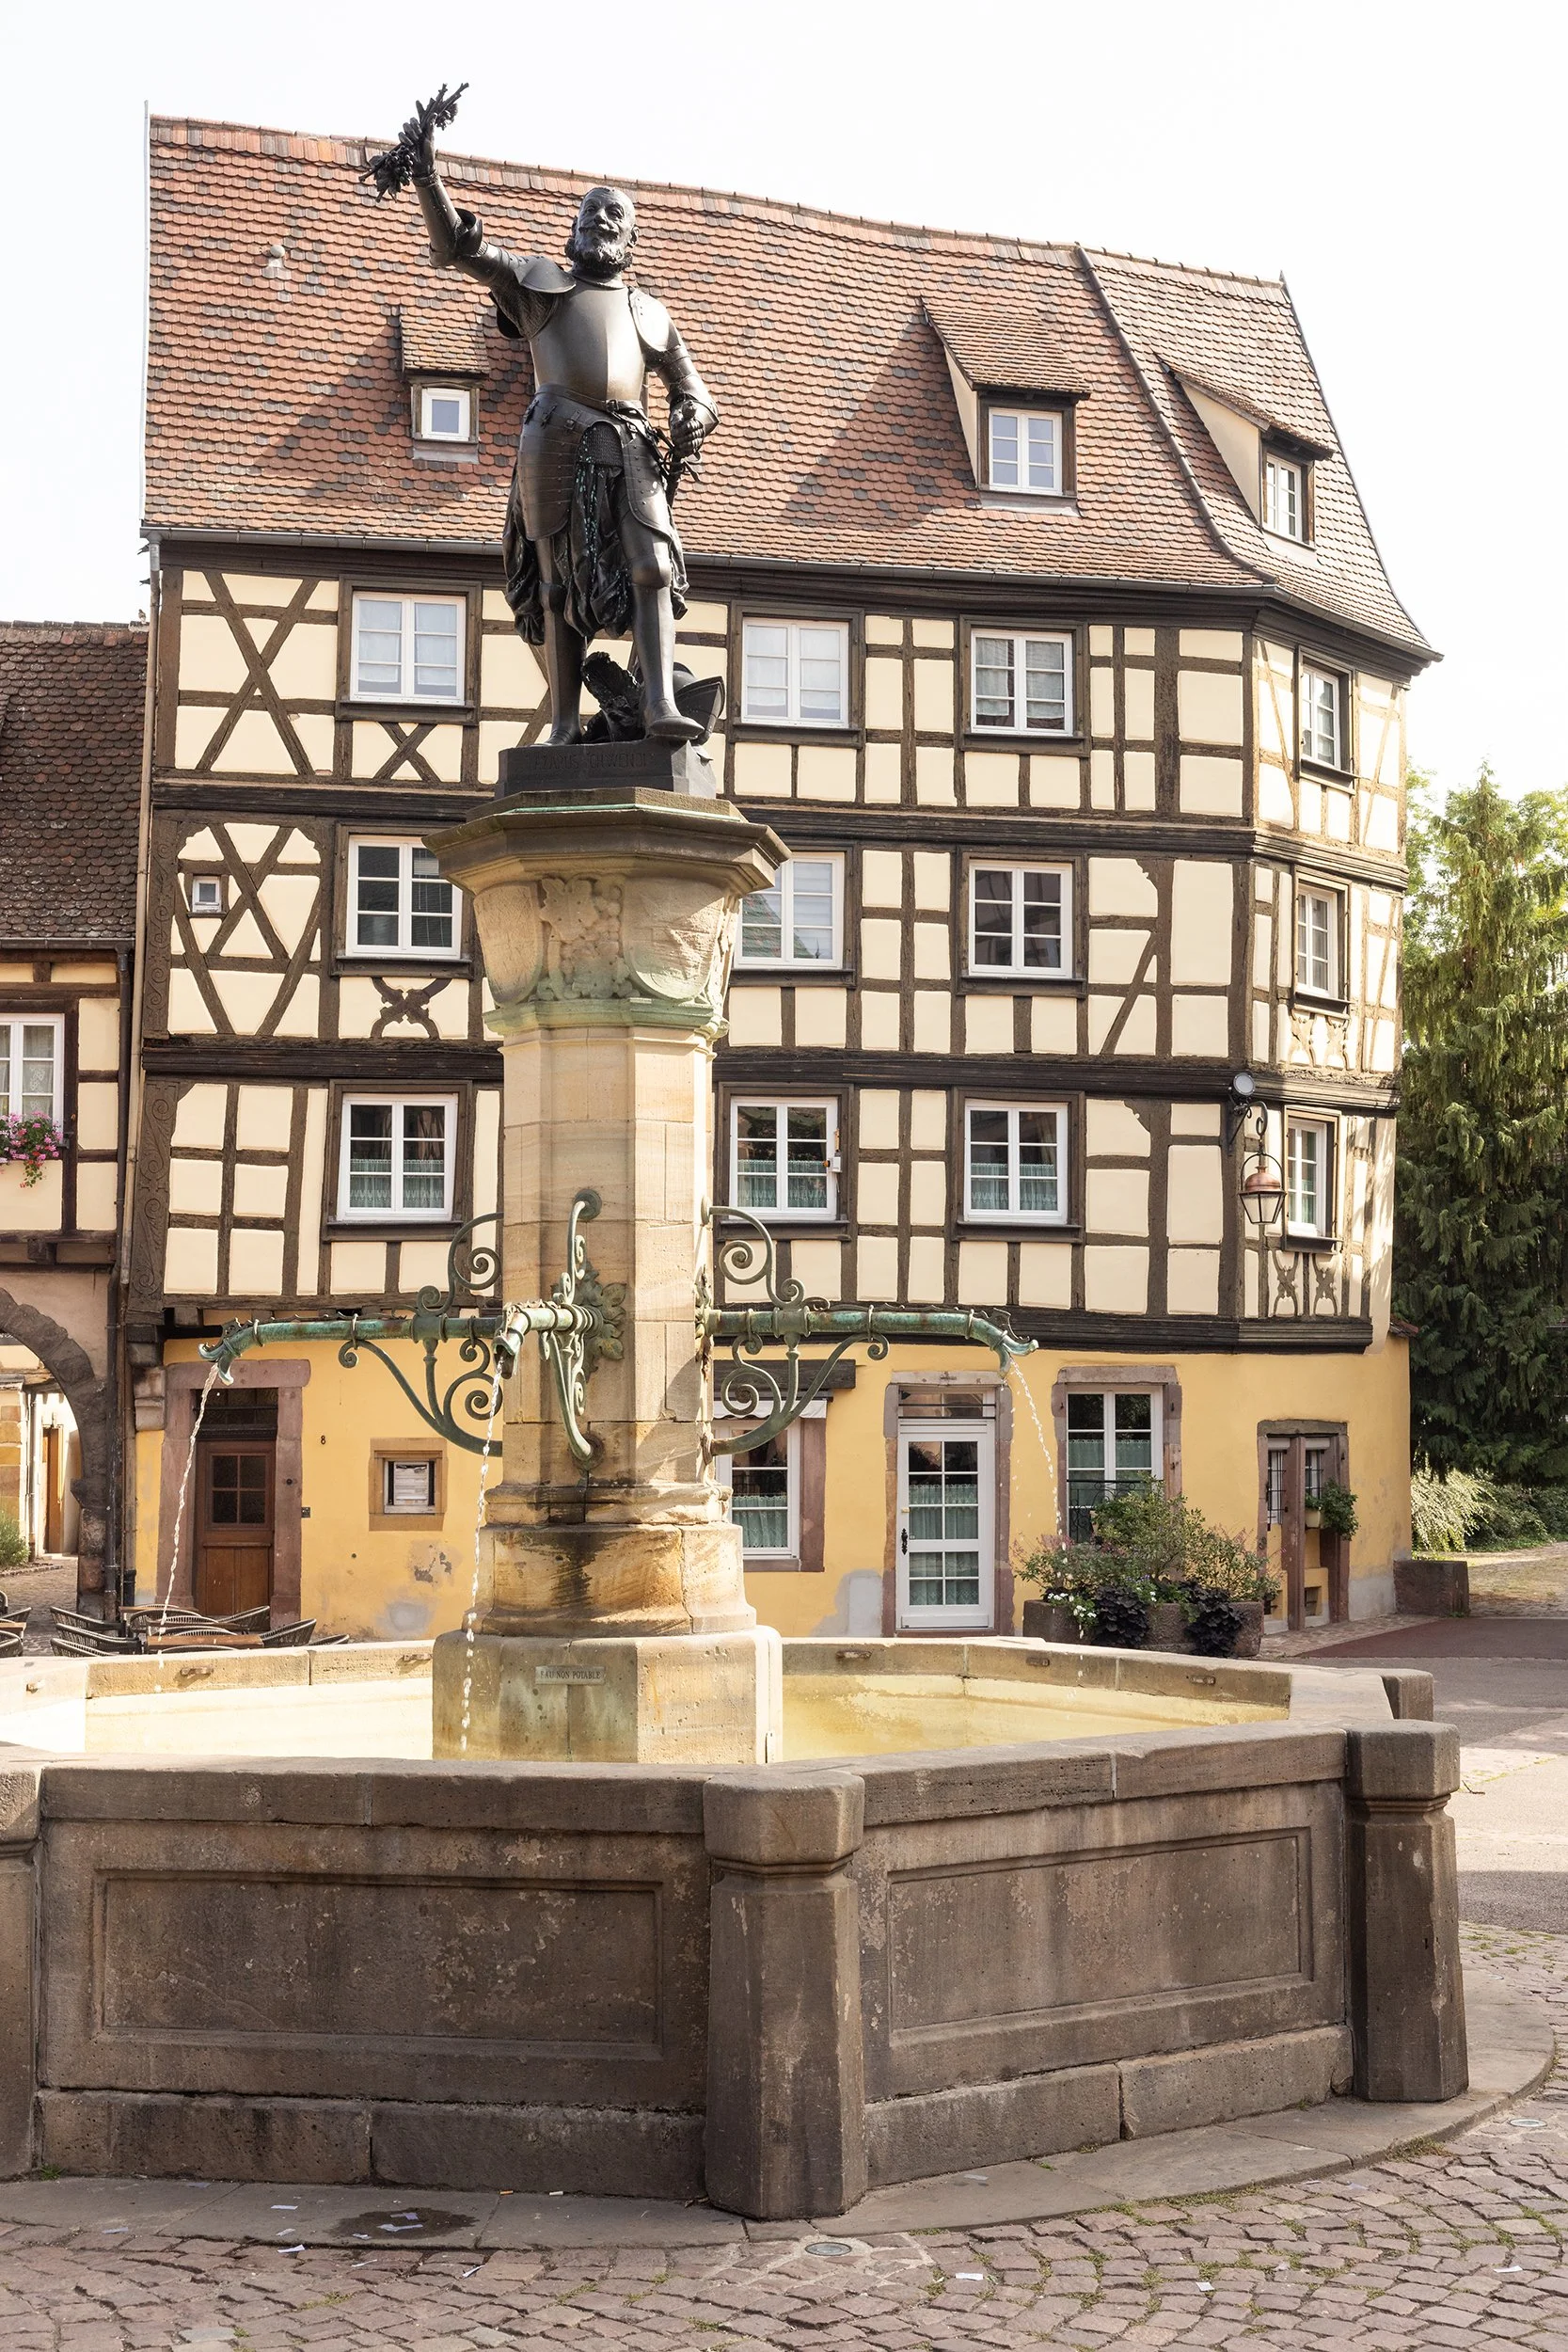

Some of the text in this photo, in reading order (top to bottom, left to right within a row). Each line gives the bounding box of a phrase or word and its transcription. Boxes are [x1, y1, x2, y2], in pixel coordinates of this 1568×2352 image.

[582, 752, 647, 769] CHWENDI
[320, 1435, 326, 1445] 8
[540, 1670, 601, 1679] EAU NON POTABLE
